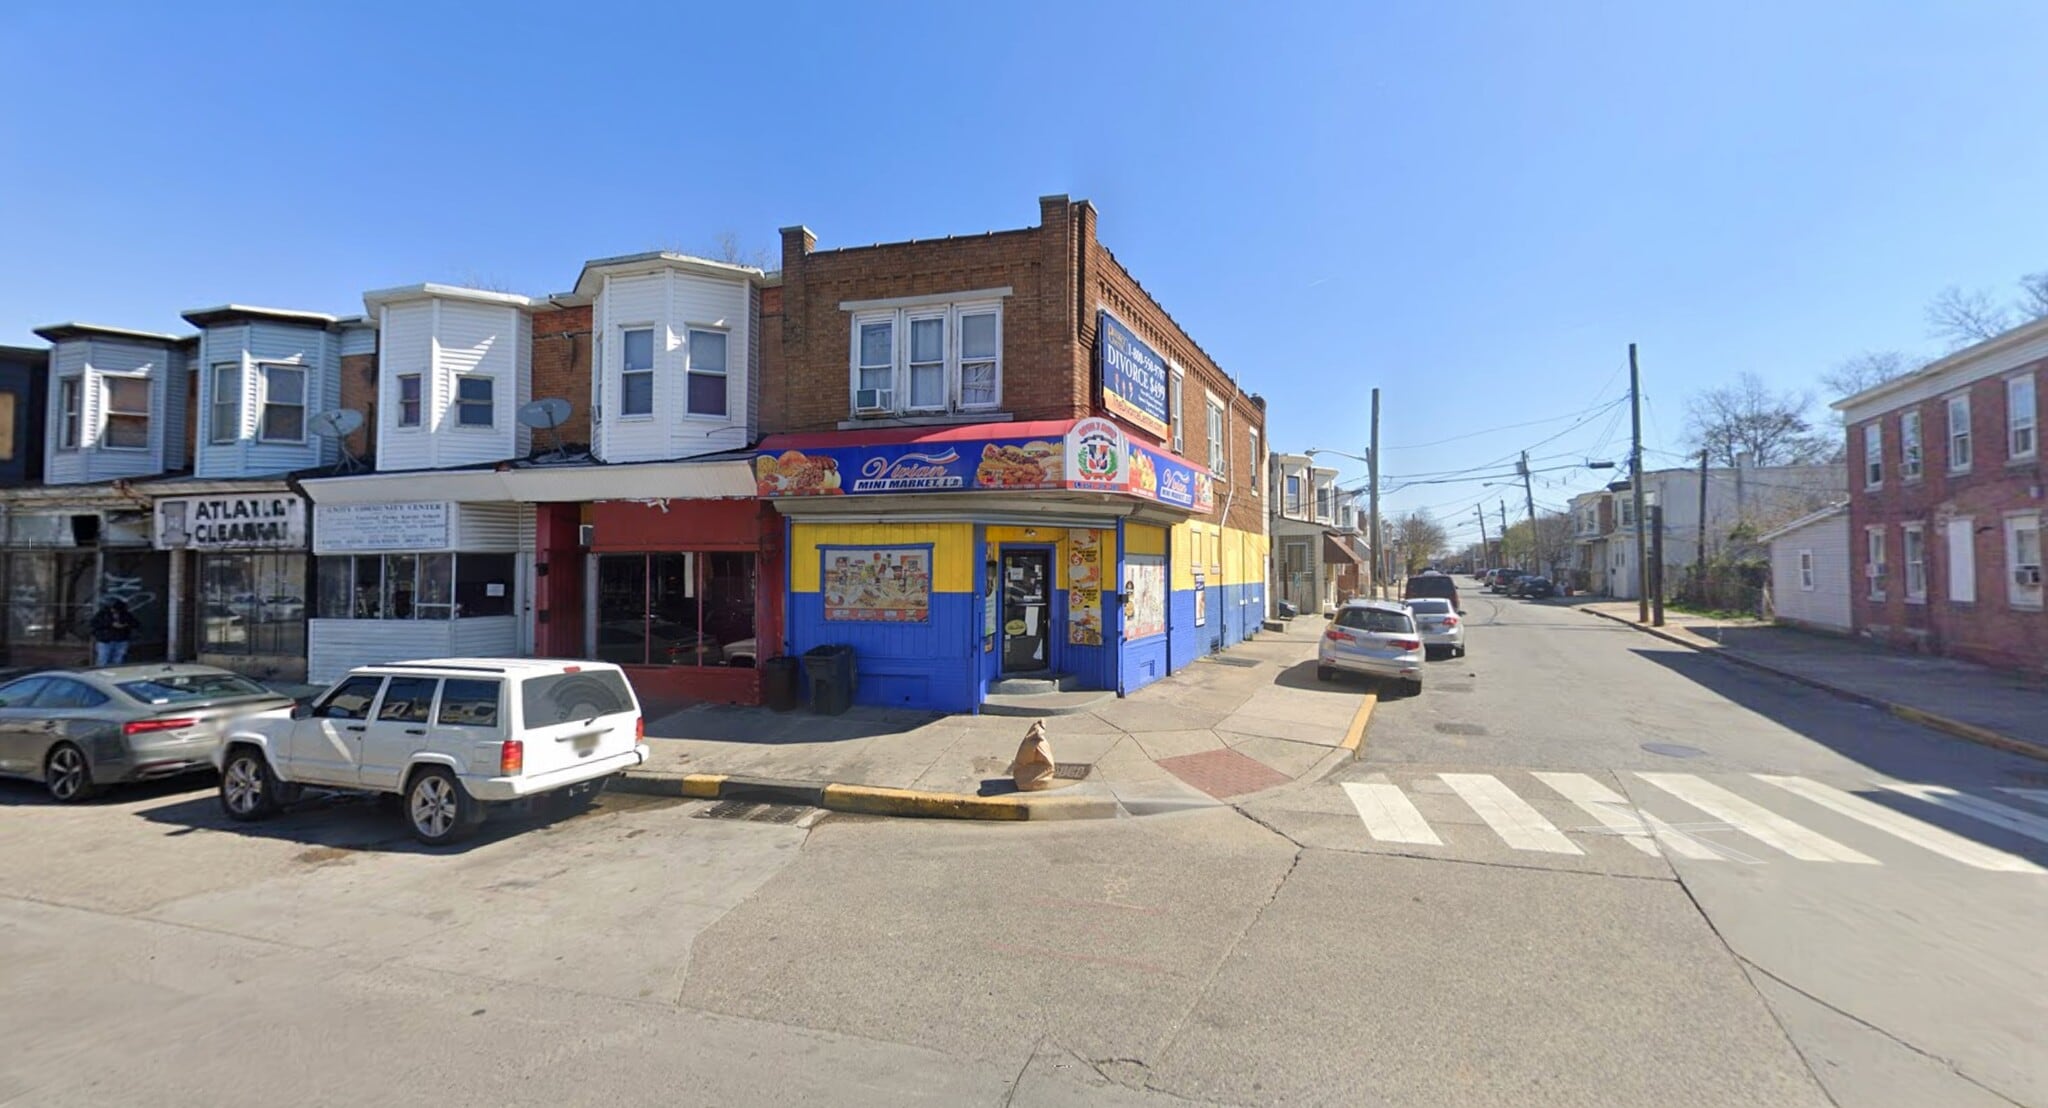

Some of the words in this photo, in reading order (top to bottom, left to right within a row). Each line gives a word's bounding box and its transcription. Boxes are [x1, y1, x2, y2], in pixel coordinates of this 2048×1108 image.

[1107, 343, 1149, 390] DIVORCE
[1150, 376, 1166, 401] $499
[862, 456, 948, 480] Vivian
[858, 480, 886, 489] MINI
